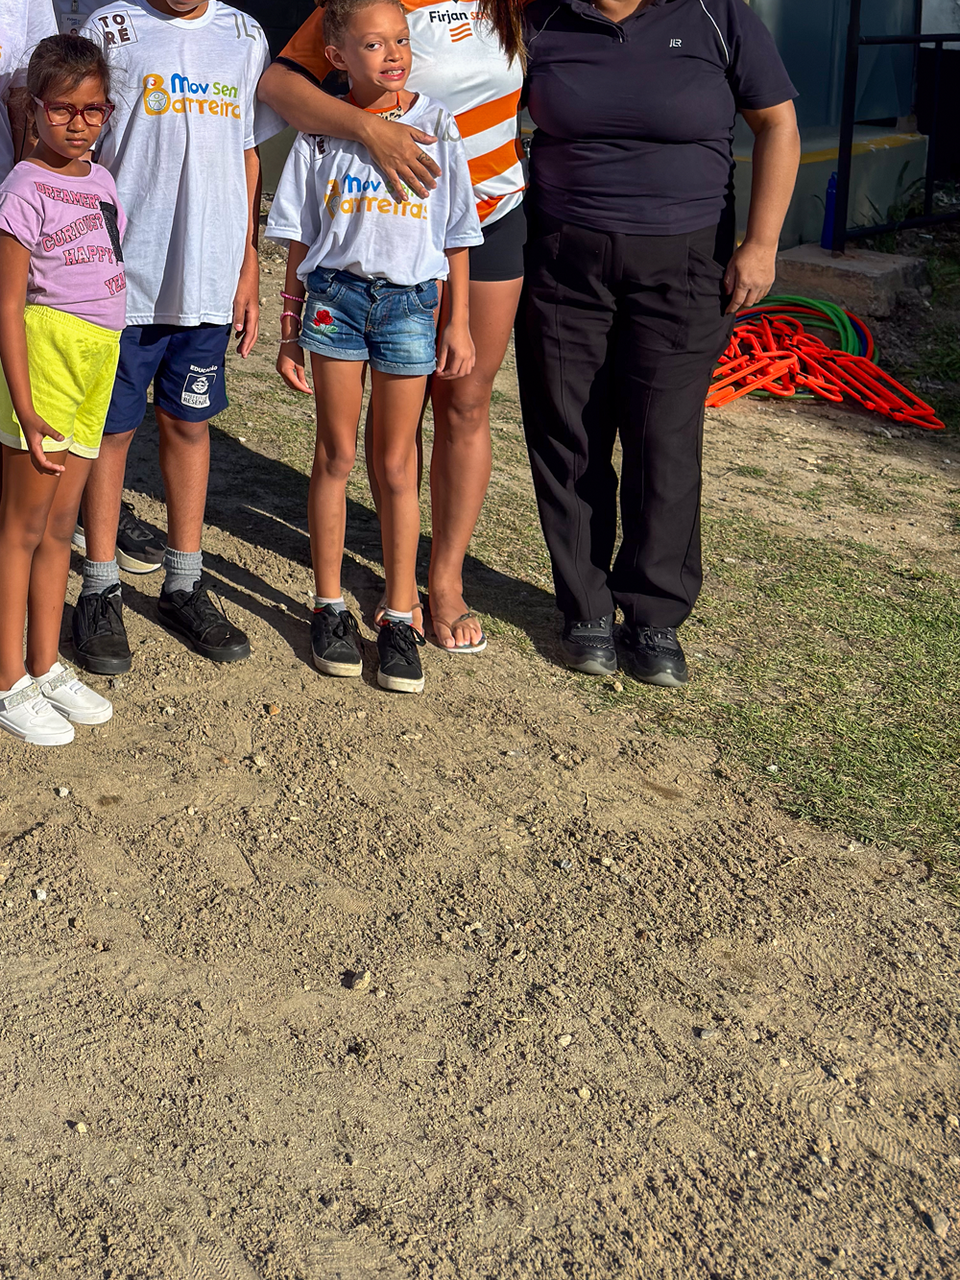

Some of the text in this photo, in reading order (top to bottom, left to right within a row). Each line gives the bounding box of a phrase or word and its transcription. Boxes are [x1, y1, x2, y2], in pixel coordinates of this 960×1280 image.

[98, 14, 126, 28] TO
[428, 10, 468, 24] Firjan
[105, 26, 131, 46] RÉ
[669, 38, 682, 48] JLR
[171, 73, 210, 94] Mov
[143, 73, 241, 120] Barreira
[341, 173, 382, 195] Mov
[41, 212, 104, 253] CURIOUS?
